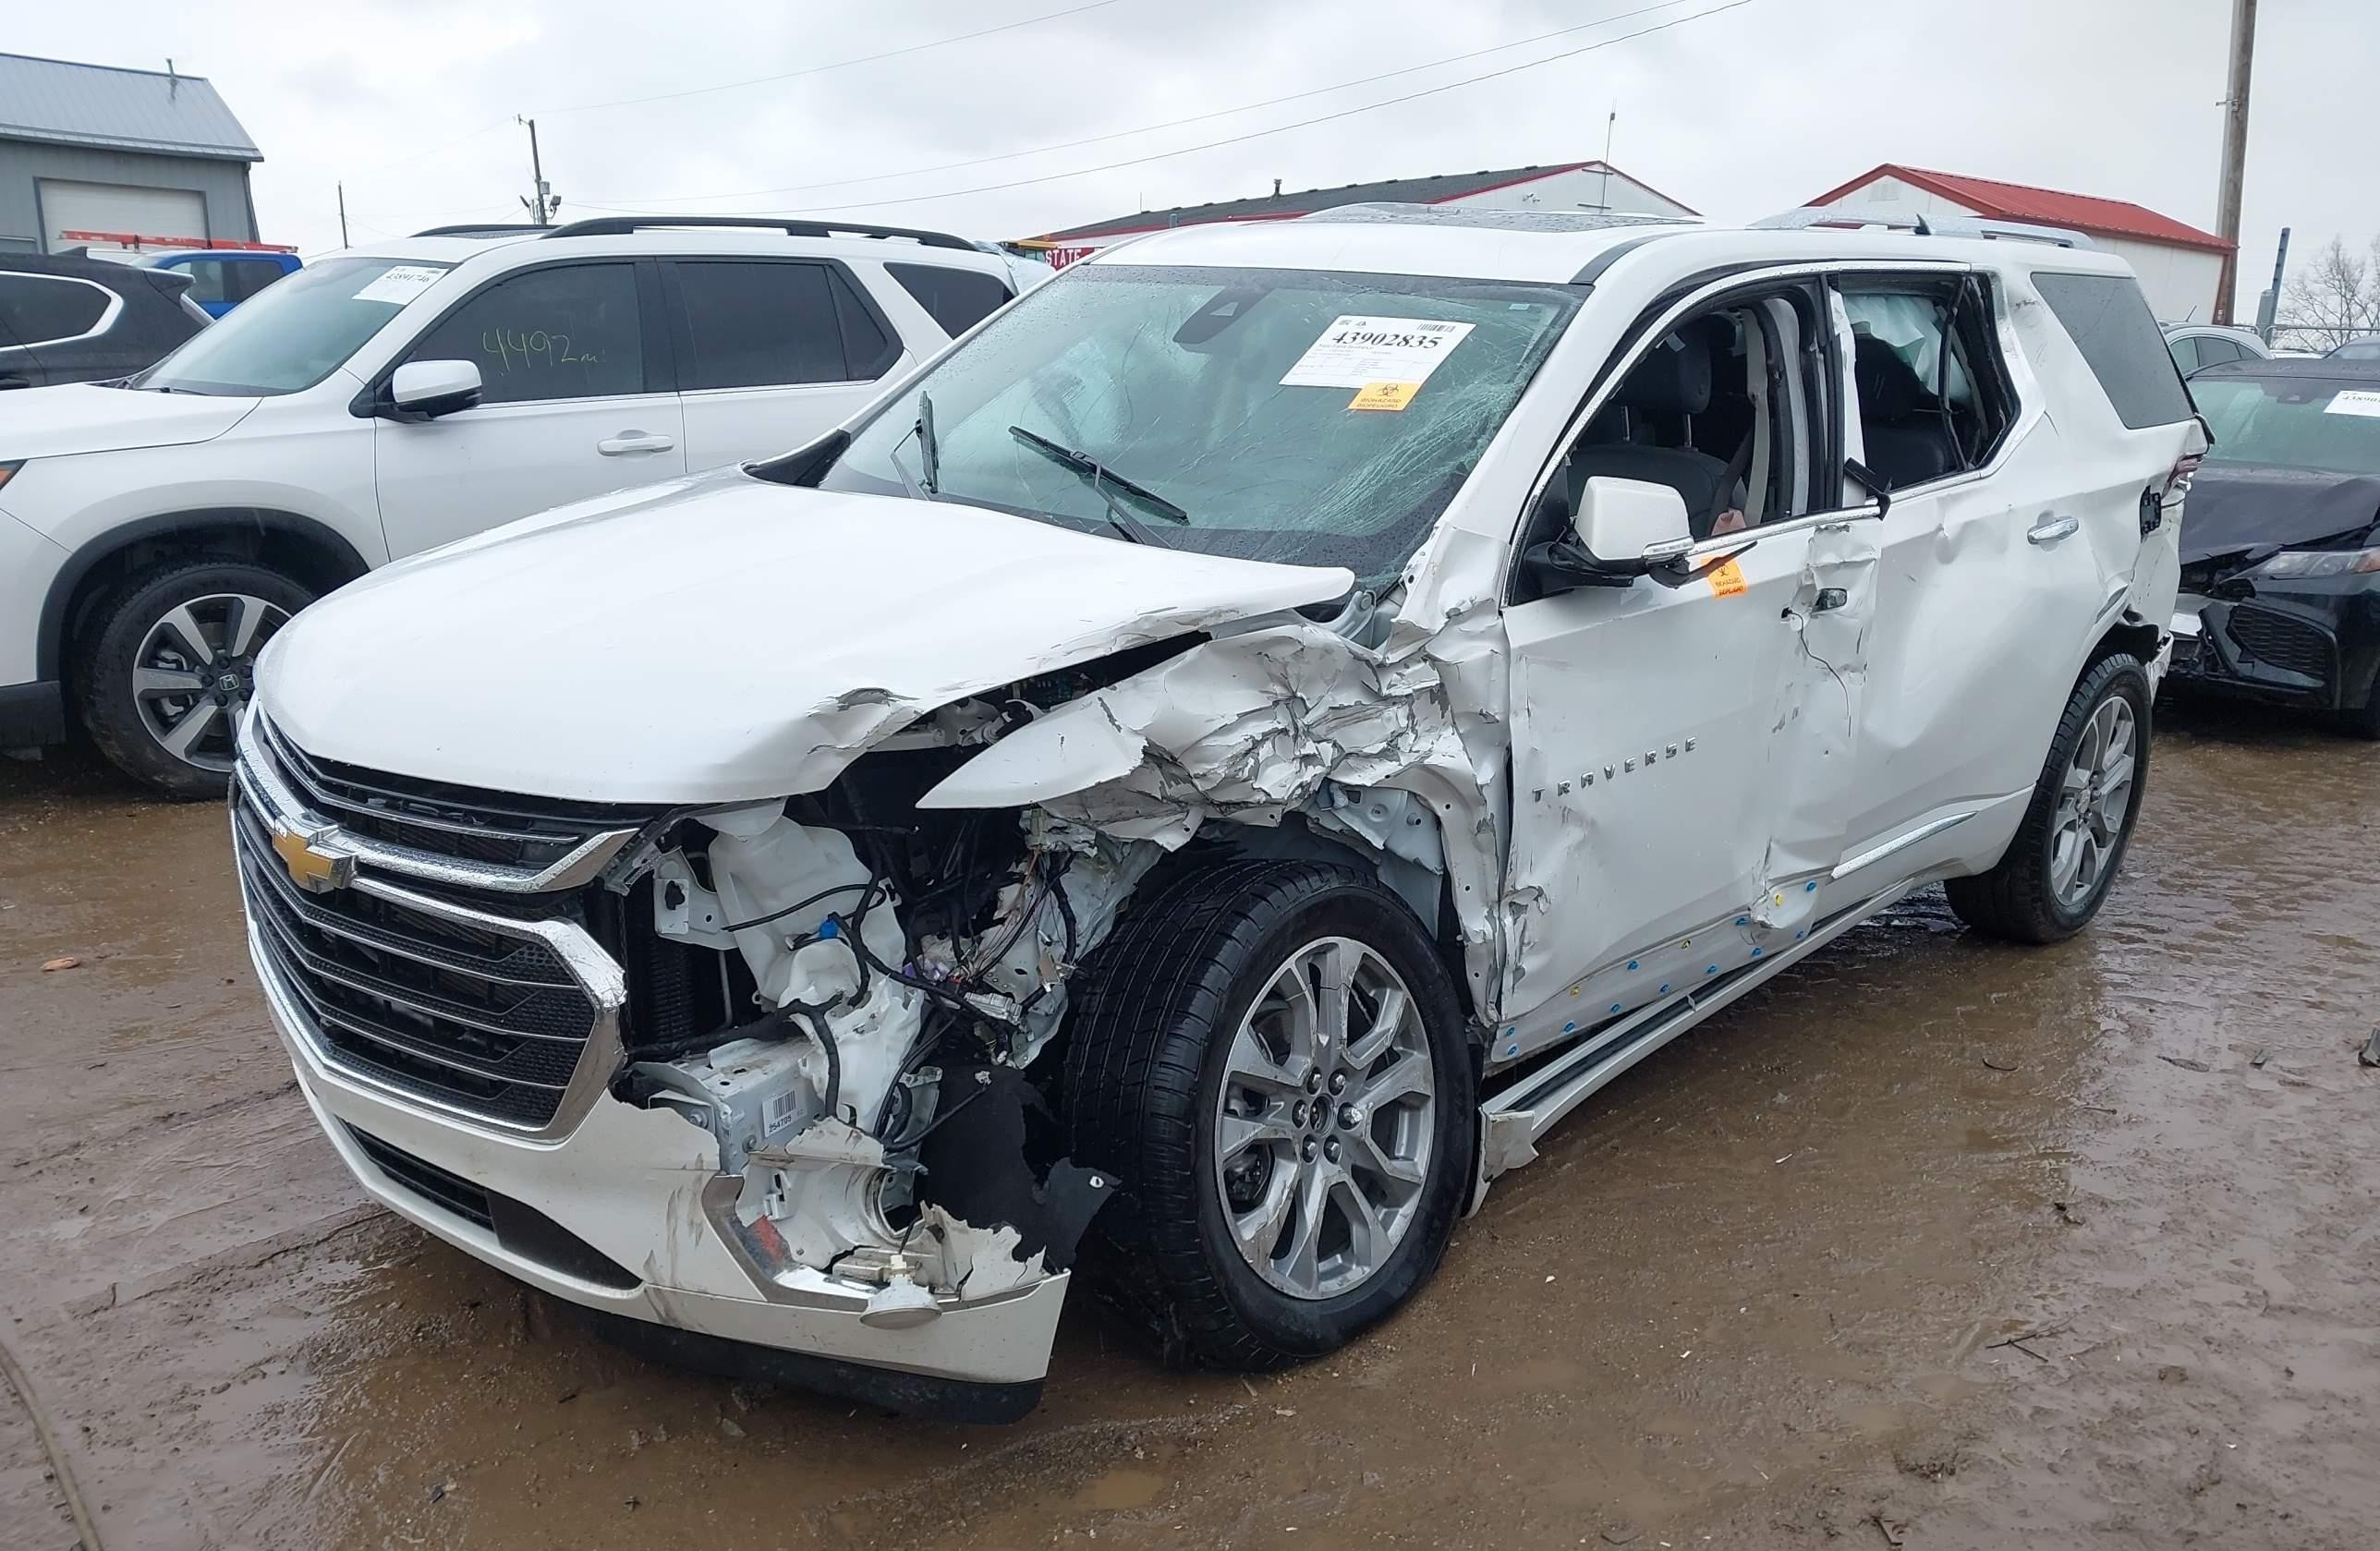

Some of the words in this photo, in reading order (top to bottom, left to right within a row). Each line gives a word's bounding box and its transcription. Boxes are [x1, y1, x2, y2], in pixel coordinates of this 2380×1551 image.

[1045, 248, 1082, 266] STATE
[1331, 331, 1444, 350] 43902835
[1531, 736, 1697, 804] TRAVERSE
